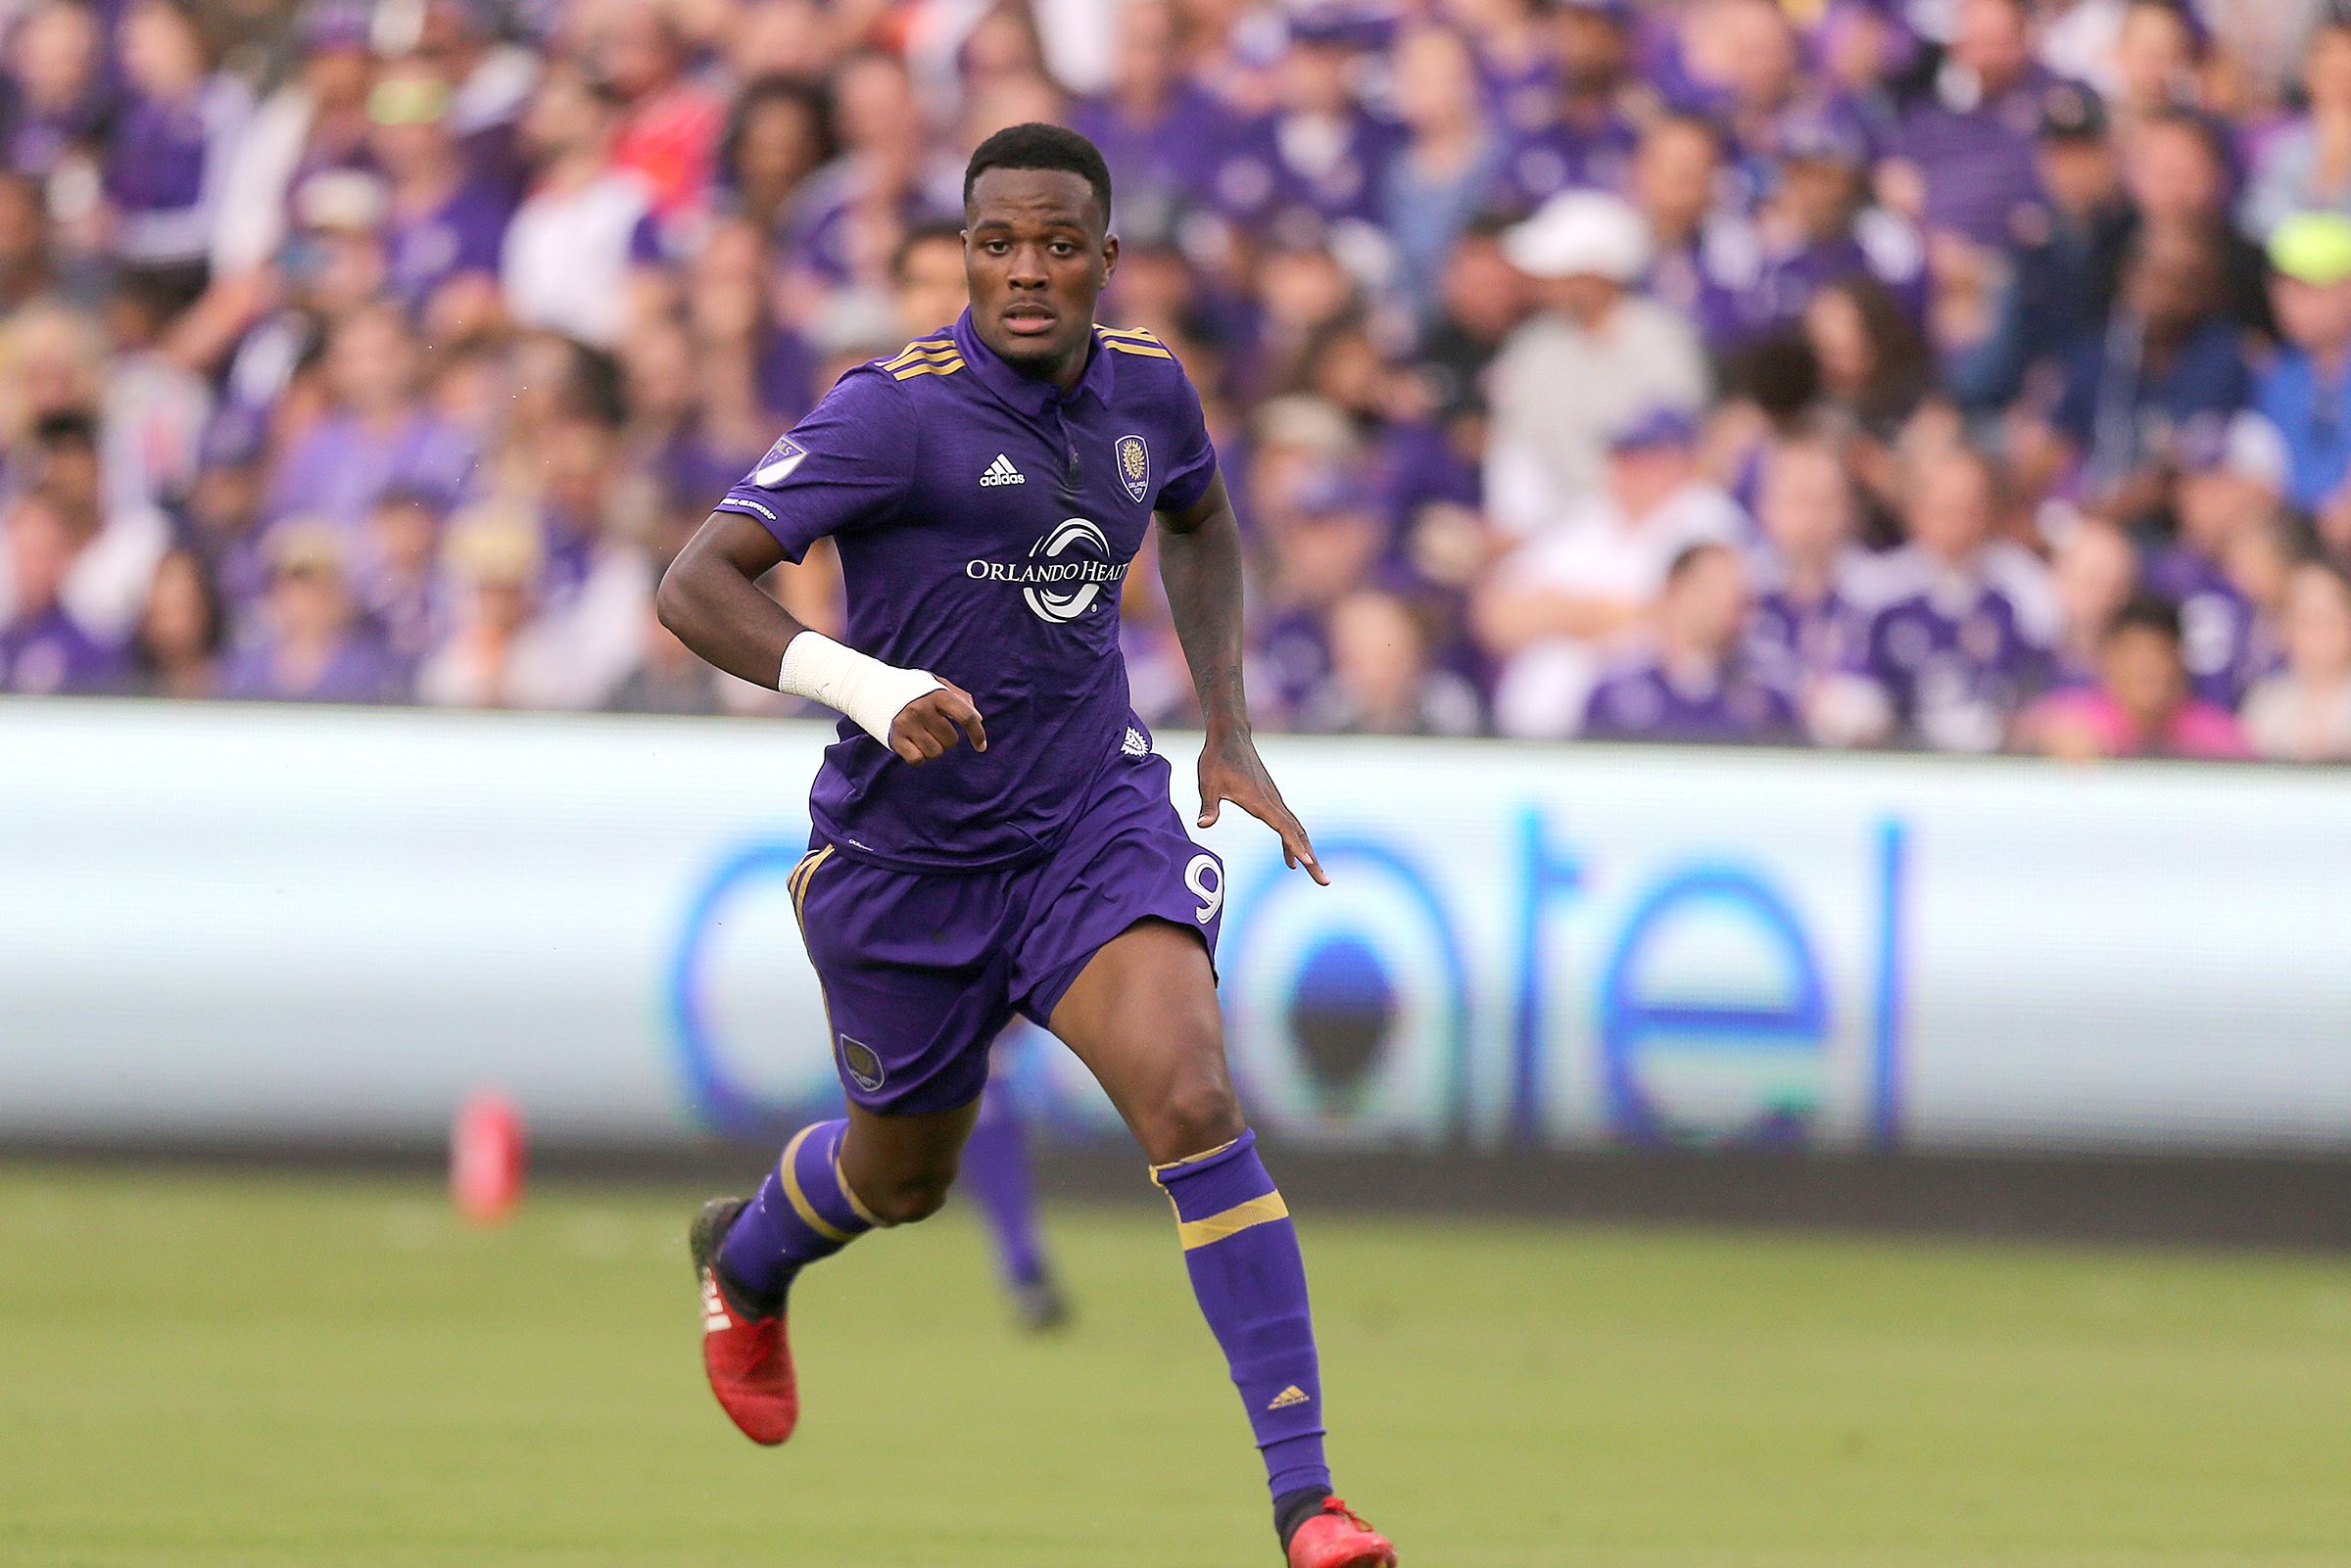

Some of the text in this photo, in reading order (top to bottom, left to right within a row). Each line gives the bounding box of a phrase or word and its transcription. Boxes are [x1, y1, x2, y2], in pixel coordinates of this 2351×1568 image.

[776, 441, 792, 456] MLS
[980, 472, 1026, 487] adidas
[966, 559, 1129, 583] ORLANDO HEALT
[1183, 853, 1223, 925] 9
